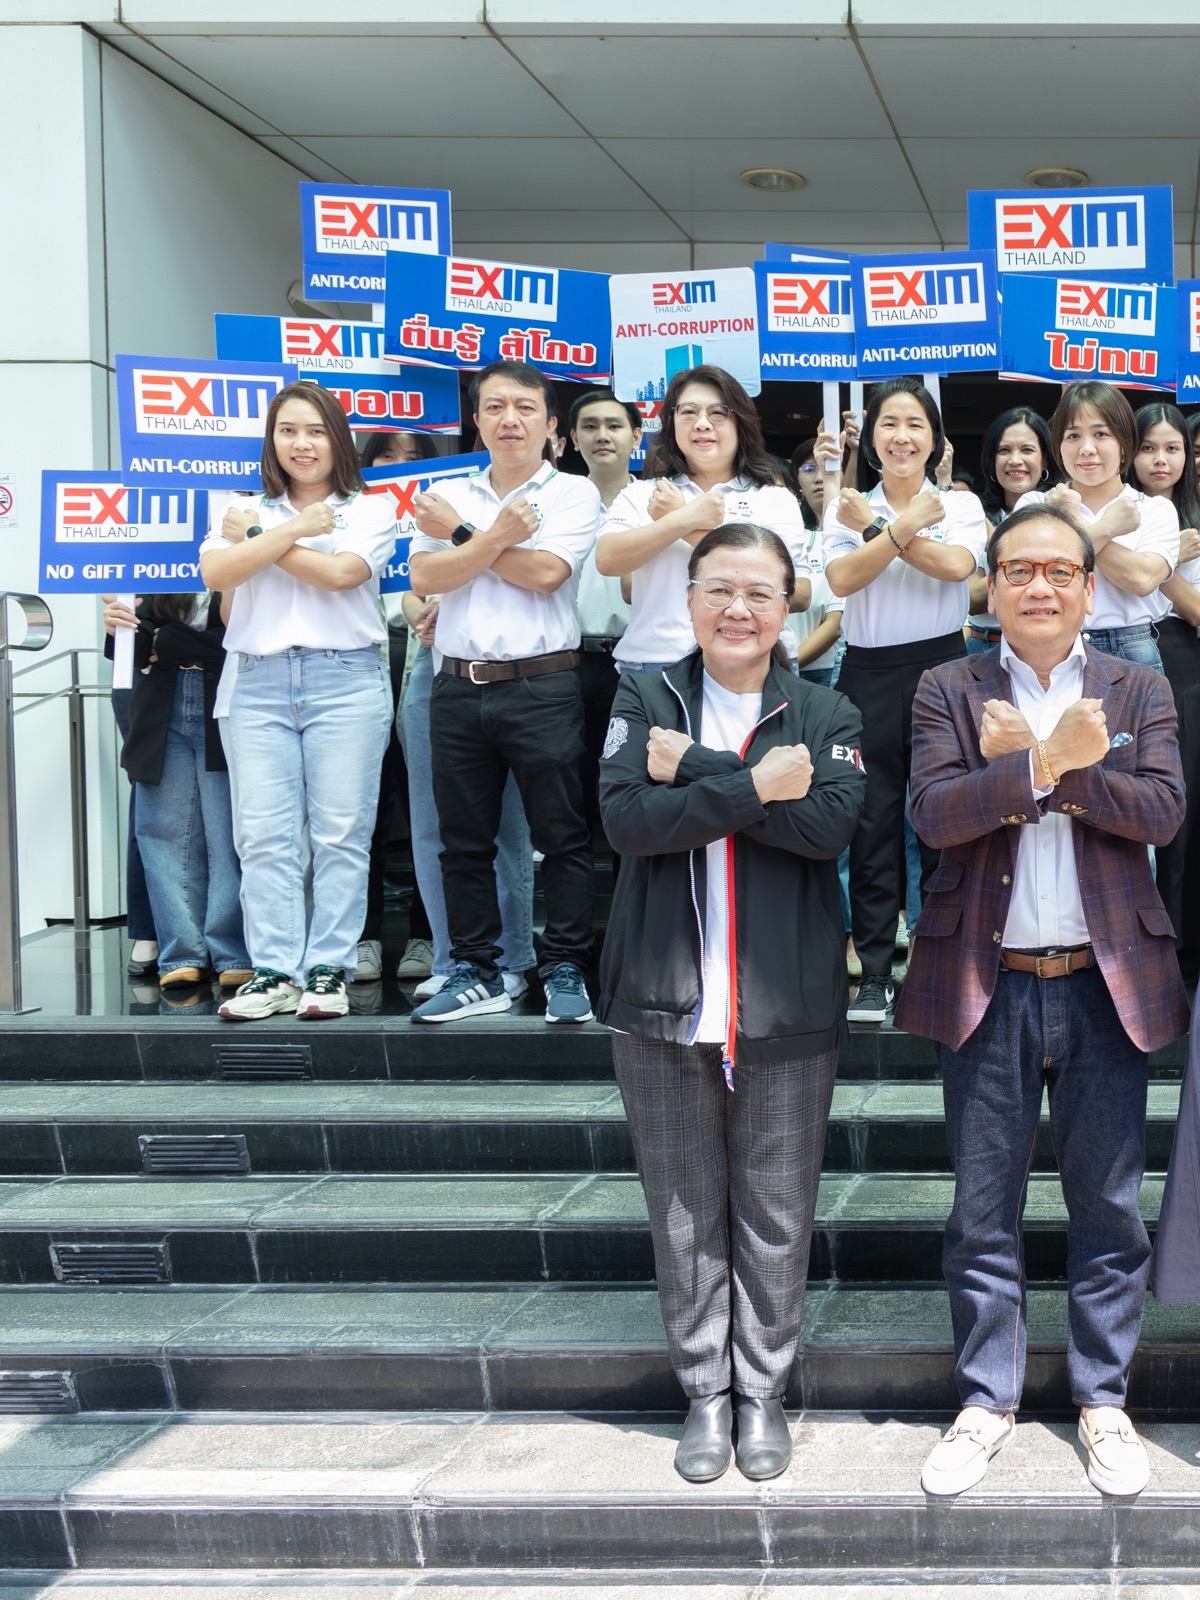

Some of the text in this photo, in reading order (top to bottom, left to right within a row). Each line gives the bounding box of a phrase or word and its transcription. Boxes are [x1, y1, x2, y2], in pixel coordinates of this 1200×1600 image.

[322, 237, 389, 251] THAILAND
[1004, 251, 1086, 265] THAILAND
[451, 297, 513, 313] THAILAND
[654, 305, 693, 314] THAILAND
[872, 308, 938, 321] THAILAND
[615, 318, 754, 338] ANTI-CORRUPTION
[774, 316, 840, 328] THAILAND
[1060, 316, 1116, 329] THAILAND
[862, 343, 997, 362] ANTI-CORRUPTION
[1044, 332, 1157, 377] ไม่ทน
[143, 416, 227, 432] THAILAND
[63, 526, 139, 538] THAILAND
[46, 563, 200, 579] NO GIFT POLICY
